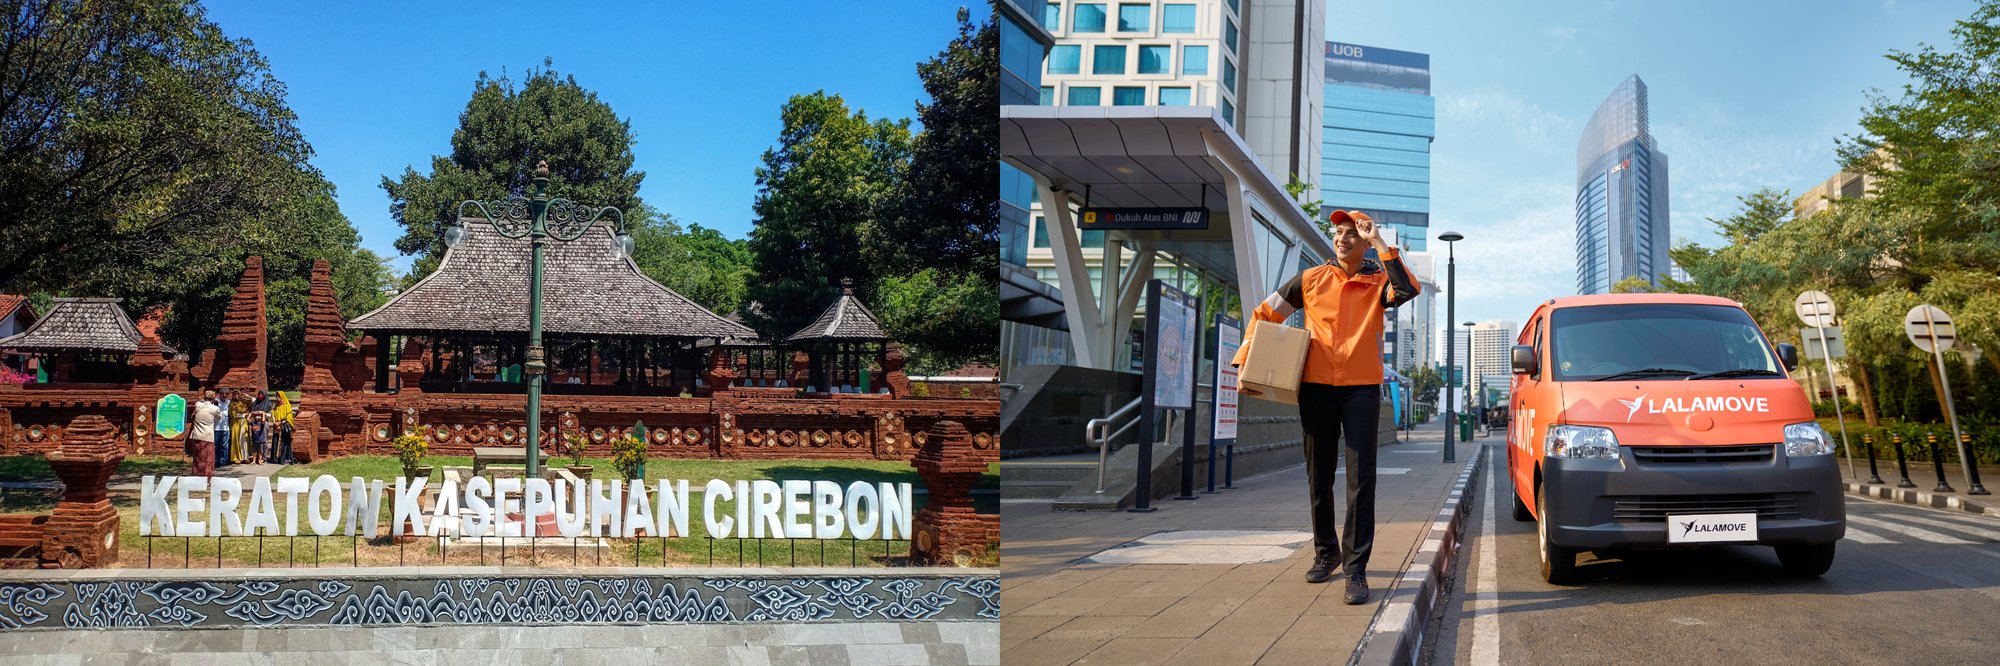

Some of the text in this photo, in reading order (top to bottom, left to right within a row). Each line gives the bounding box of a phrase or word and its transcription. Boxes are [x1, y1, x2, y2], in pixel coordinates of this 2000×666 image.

[1333, 44, 1363, 58] UOB
[1115, 213, 1178, 222] Dukuh Atas BNI
[1648, 396, 1769, 415] LALAMOVE
[139, 475, 912, 540] KERATON KASEPUHAN CIREBON
[1694, 522, 1747, 534] LALAMOVE
